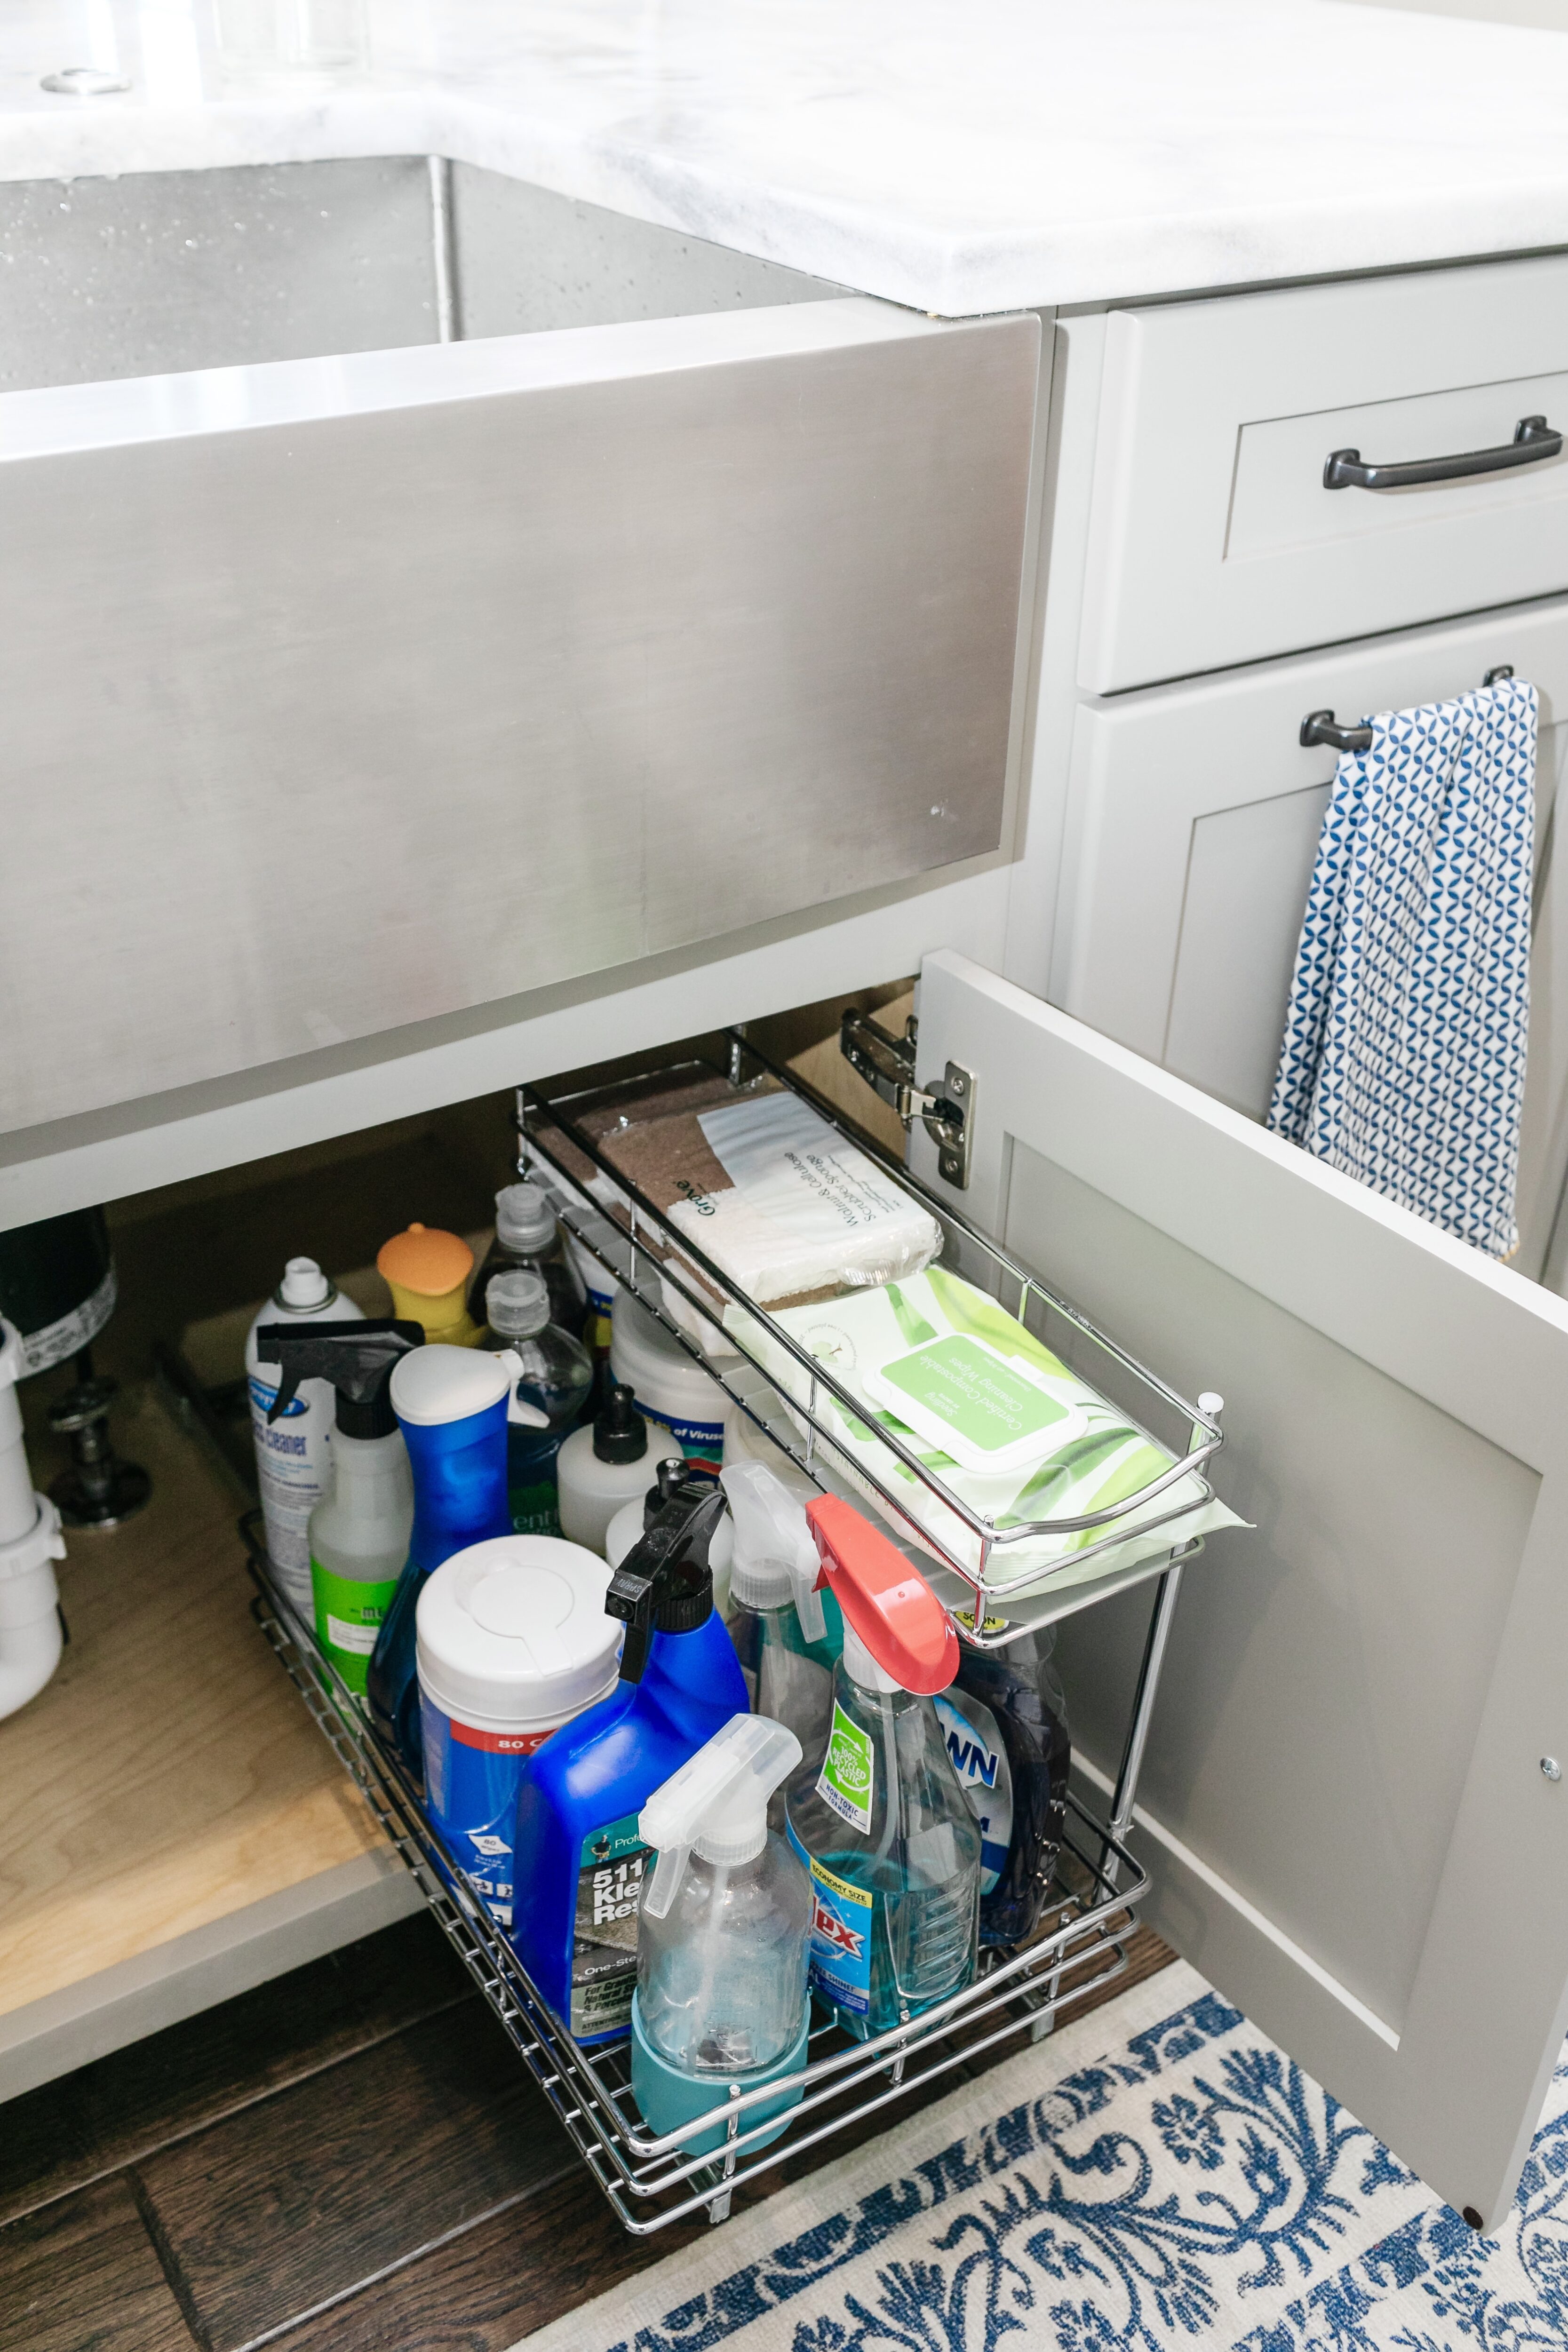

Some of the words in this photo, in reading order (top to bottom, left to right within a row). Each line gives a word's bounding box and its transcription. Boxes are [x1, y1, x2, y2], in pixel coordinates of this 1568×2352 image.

[784, 1152, 822, 1188] Cellulose
[806, 1154, 839, 1184] Sponge
[677, 1179, 715, 1216] Grove
[827, 1195, 859, 1226] Walnut
[836, 1184, 876, 1222] Scrubber
[920, 1355, 980, 1399] Compostable
[949, 1358, 979, 1382] Wipes
[925, 1391, 957, 1416] Seedling
[979, 1378, 1023, 1412] Cleaning
[975, 1397, 1022, 1430] Certified
[674, 1428, 688, 1437] of
[616, 1578, 643, 1594] SPRAY
[498, 1740, 525, 1749] 80
[841, 1746, 859, 1766] 100%
[832, 1746, 867, 1780] RECYCLED
[833, 1759, 862, 1787] PLASTIC
[826, 1783, 859, 1817] NON-TOXIC
[828, 1796, 852, 1820] FORMULA
[592, 1858, 643, 1889] 511
[812, 1864, 847, 1893] ECONOMY
[848, 1890, 867, 1902] SIZE
[584, 1986, 622, 2005] Natural
[585, 1986, 602, 1996] For
